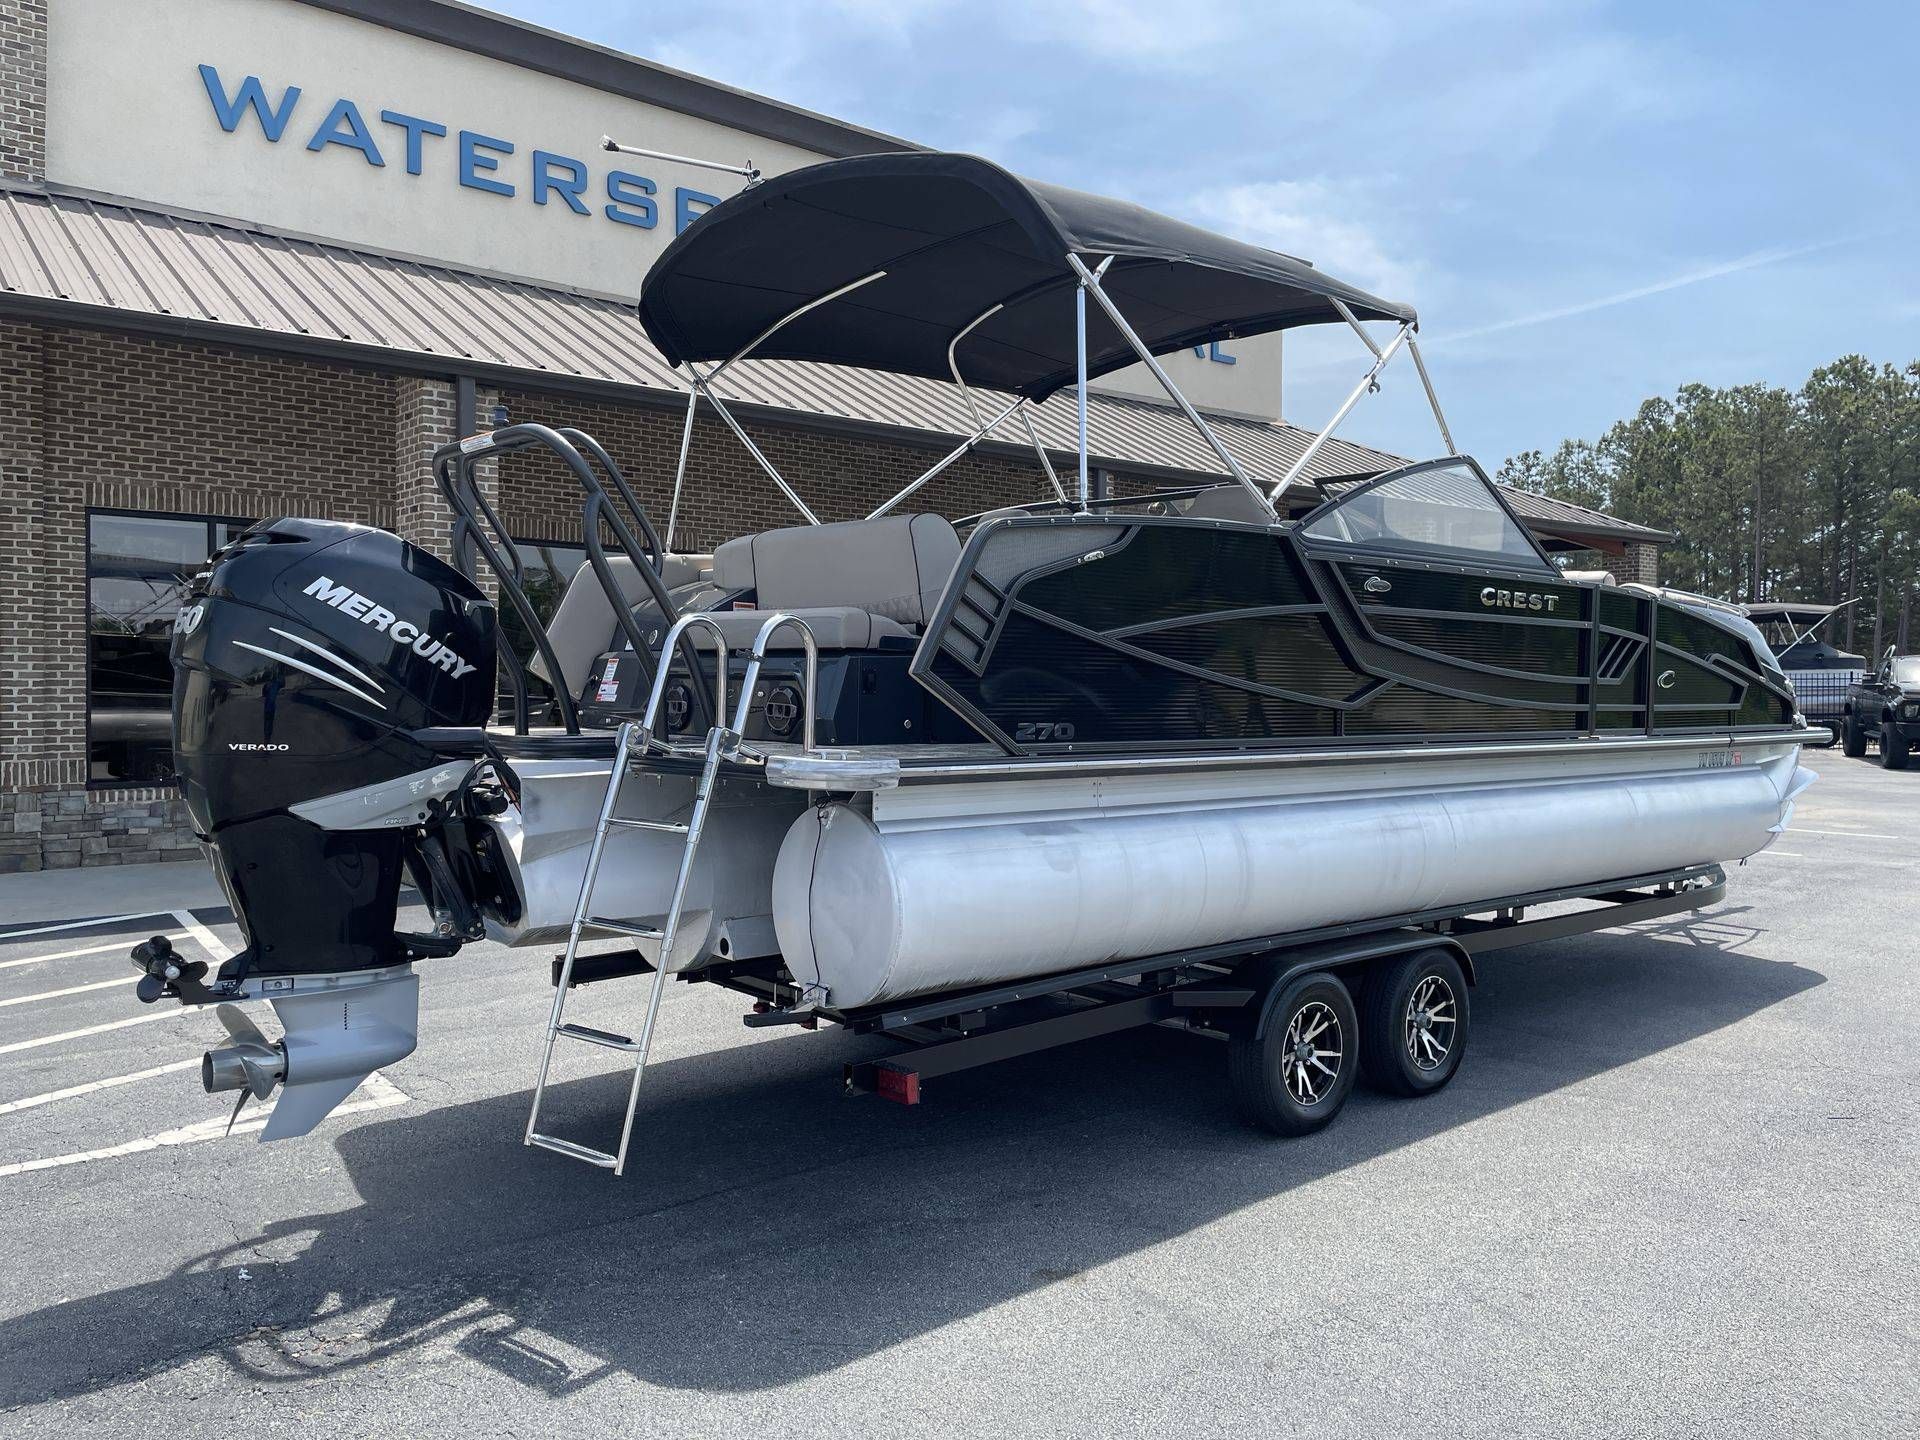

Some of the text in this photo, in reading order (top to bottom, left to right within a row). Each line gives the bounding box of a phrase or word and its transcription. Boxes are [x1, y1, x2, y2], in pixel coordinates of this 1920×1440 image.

[1480, 587, 1559, 611] CREST
[302, 575, 478, 680] MERCURY
[1015, 722, 1075, 741] 270
[228, 743, 290, 751] VERADO
